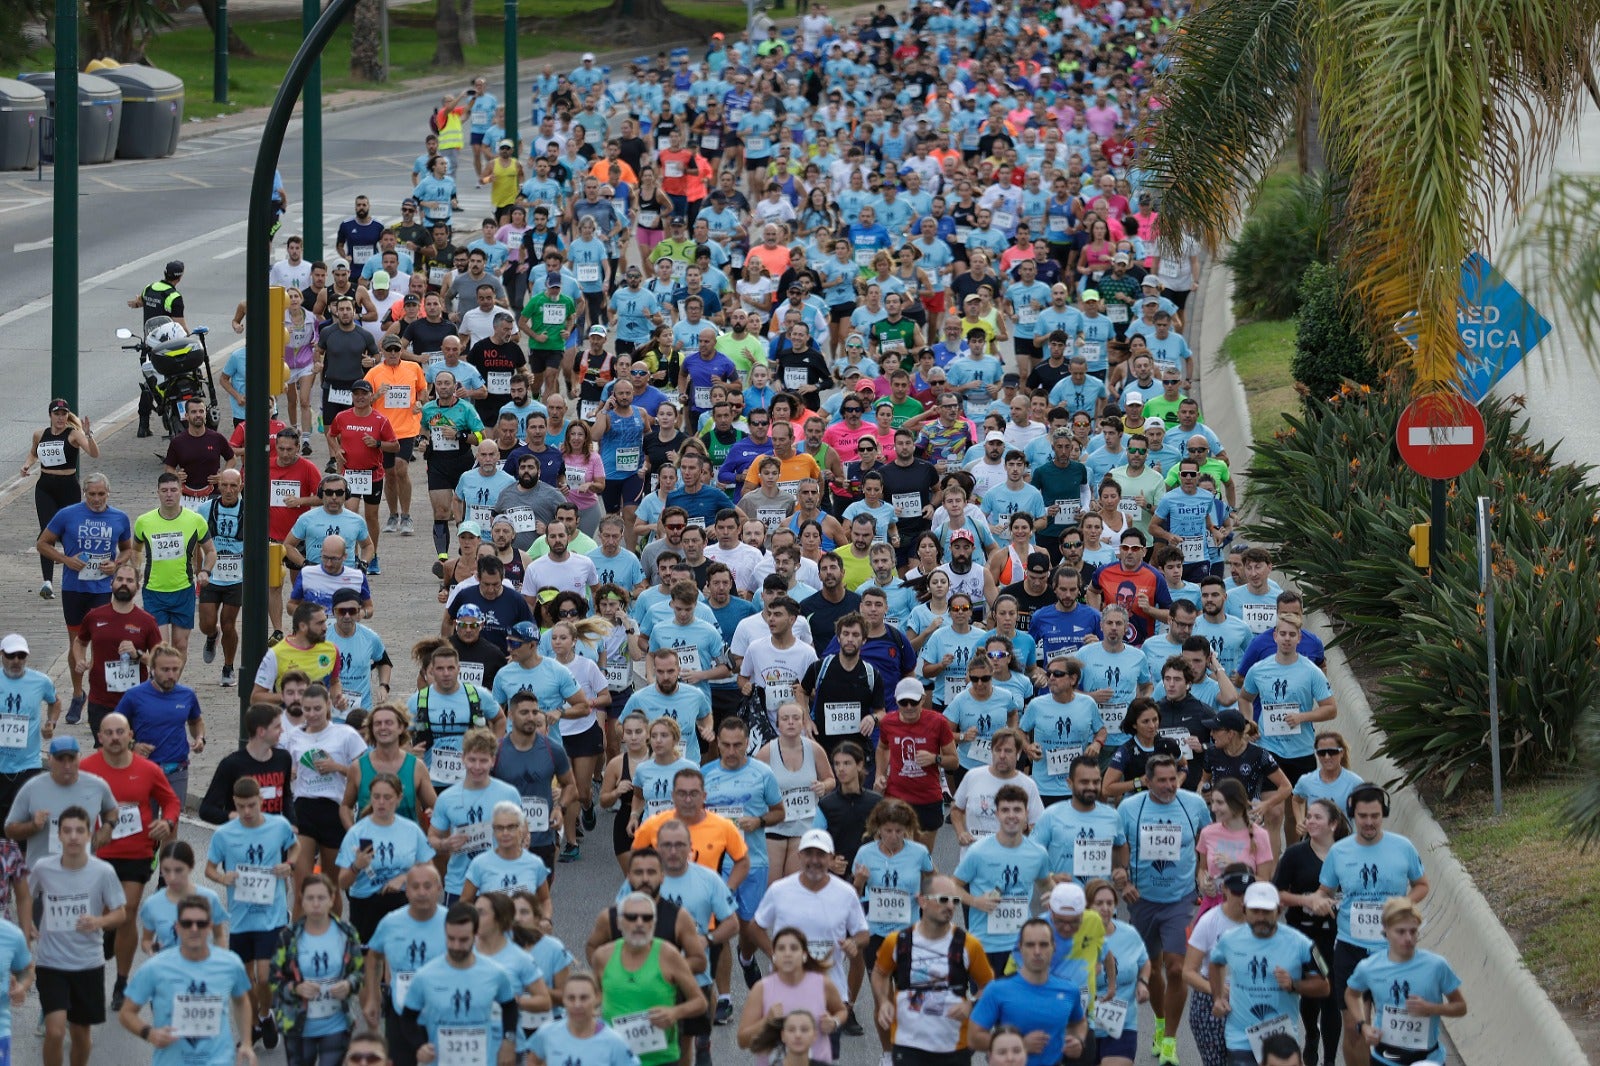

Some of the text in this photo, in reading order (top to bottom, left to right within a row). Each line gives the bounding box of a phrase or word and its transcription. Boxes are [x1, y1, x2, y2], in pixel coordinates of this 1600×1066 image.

[1462, 328, 1521, 349] SICA
[484, 350, 498, 359] NO
[484, 359, 514, 368] GUERRA
[389, 390, 408, 399] 3092
[346, 424, 372, 433] mayoral
[41, 449, 61, 457] 3396
[349, 477, 369, 485] 3133
[1178, 505, 1205, 516] nerja
[85, 518, 107, 527] Remo
[78, 525, 113, 538] RCM
[78, 539, 112, 551] 1873
[157, 540, 180, 550] 3246
[217, 562, 238, 571] 6850
[1246, 612, 1275, 622] 11907
[831, 711, 856, 722] 9888
[1, 722, 26, 734] 1754
[436, 759, 462, 772] 6183
[785, 794, 810, 807] 1465
[1148, 835, 1176, 846] 1540
[1082, 850, 1107, 861] 1539
[242, 876, 270, 889] 3277
[876, 897, 905, 908] 3086
[49, 903, 88, 917] 11768
[994, 907, 1022, 919] 3085
[182, 1007, 216, 1020] 3095
[1095, 1005, 1123, 1023] 1727
[1389, 1019, 1423, 1032] 9792
[624, 1024, 656, 1041] 1061
[447, 1039, 480, 1053] 3213
